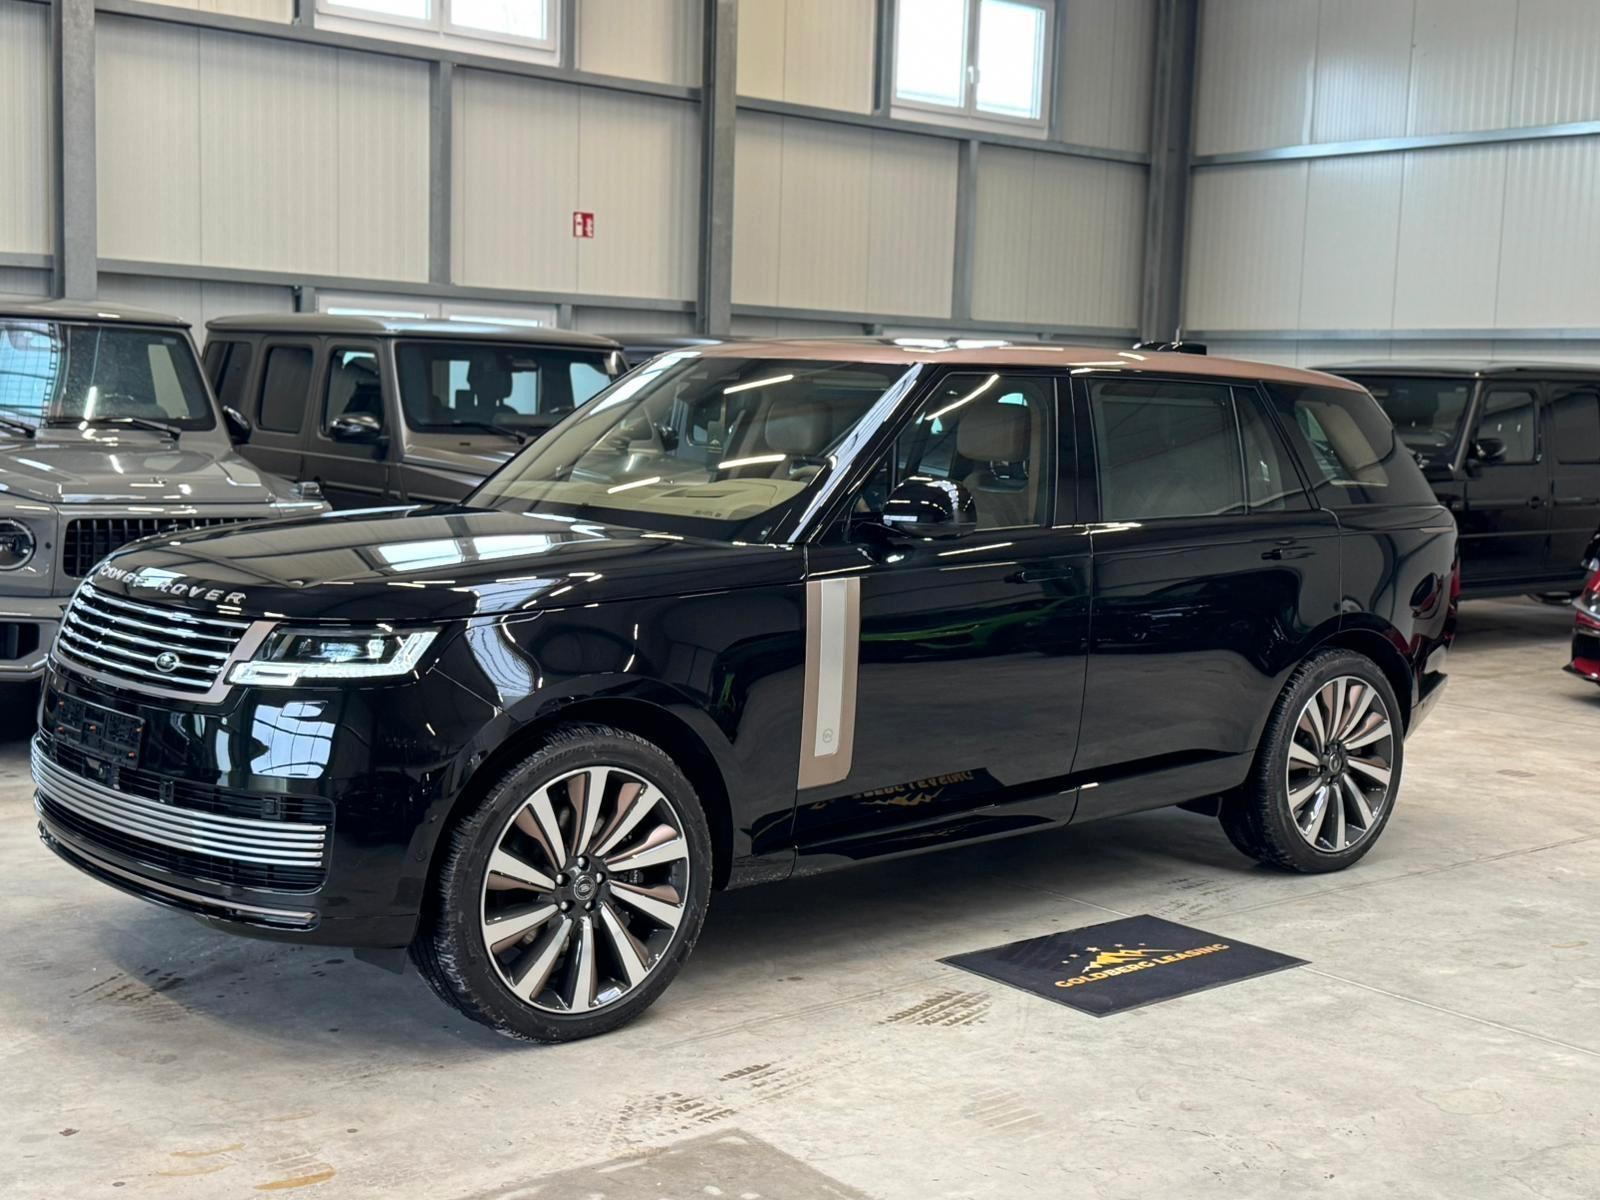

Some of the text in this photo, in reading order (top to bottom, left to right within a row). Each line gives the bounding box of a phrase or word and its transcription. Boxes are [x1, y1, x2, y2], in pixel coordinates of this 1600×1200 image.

[155, 581, 246, 605] ROVER
[1054, 943, 1230, 988] GOLDBERG LEASING
